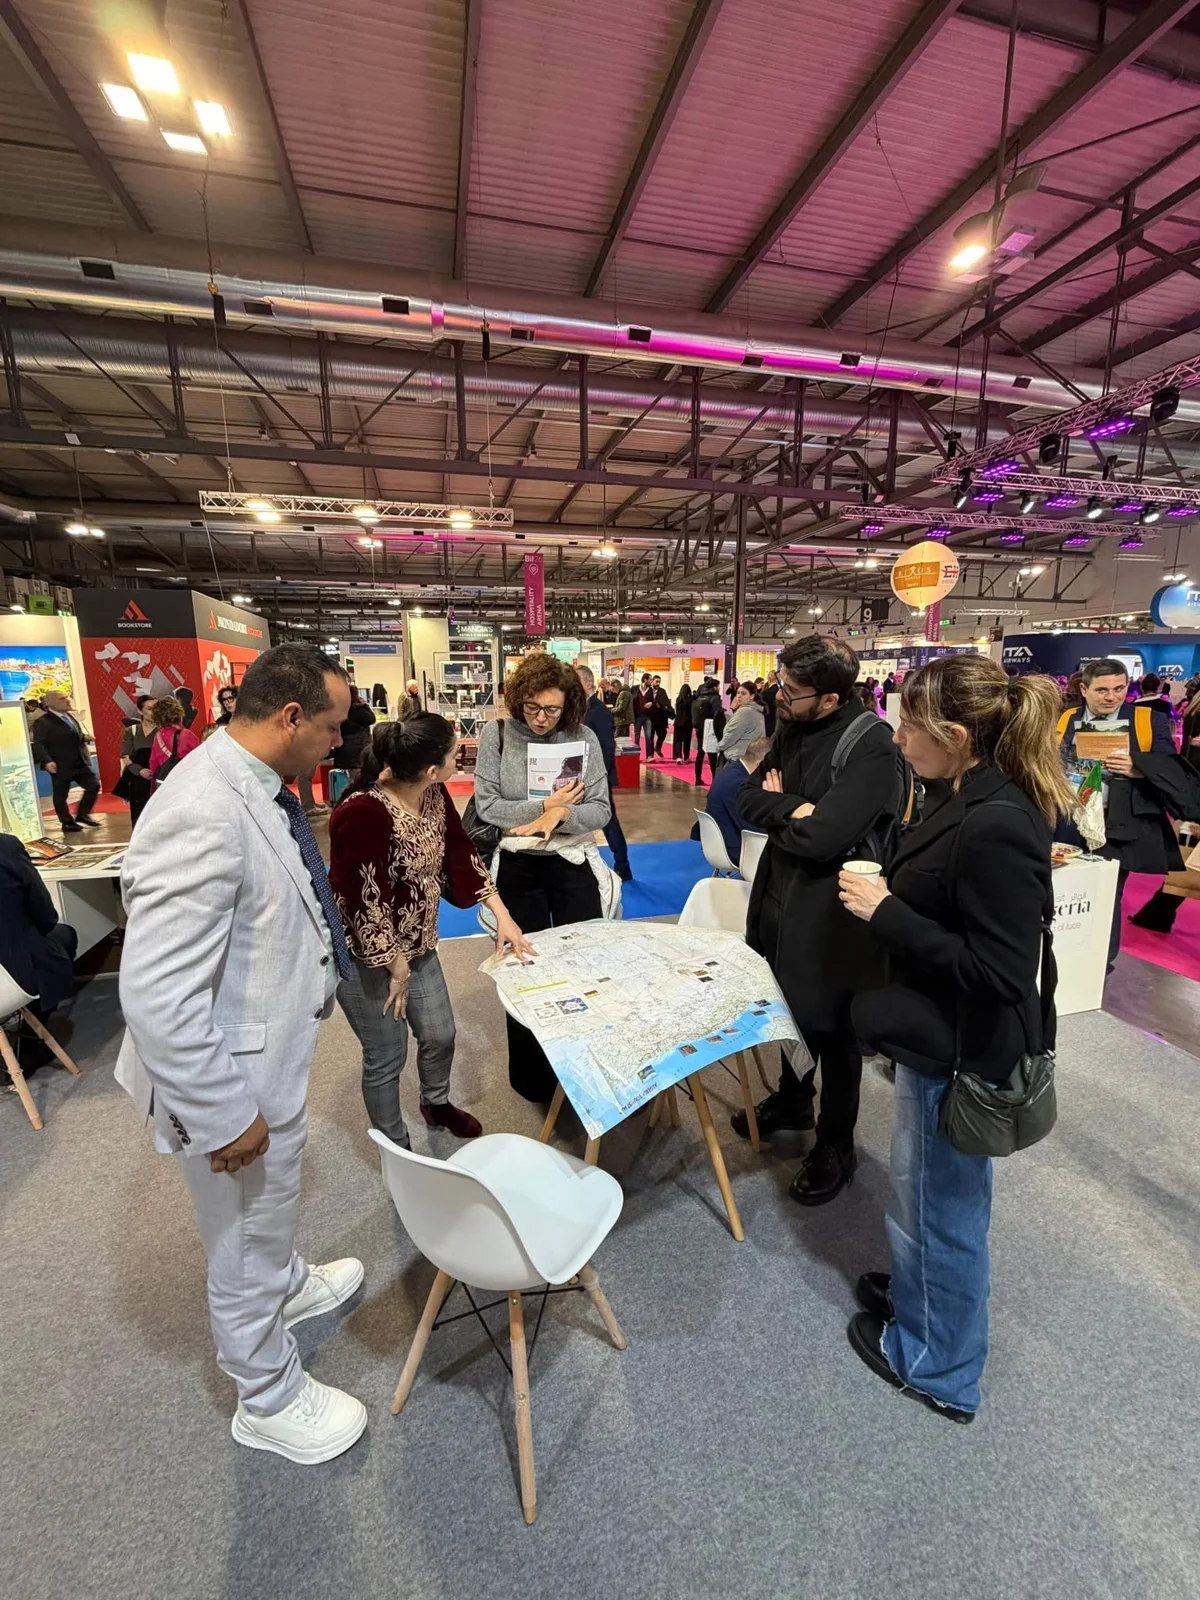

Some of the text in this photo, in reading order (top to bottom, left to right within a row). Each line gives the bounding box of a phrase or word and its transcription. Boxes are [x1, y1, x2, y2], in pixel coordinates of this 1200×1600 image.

[863, 608, 872, 623] 9
[1003, 646, 1034, 657] ITA
[1157, 664, 1185, 672] ITA
